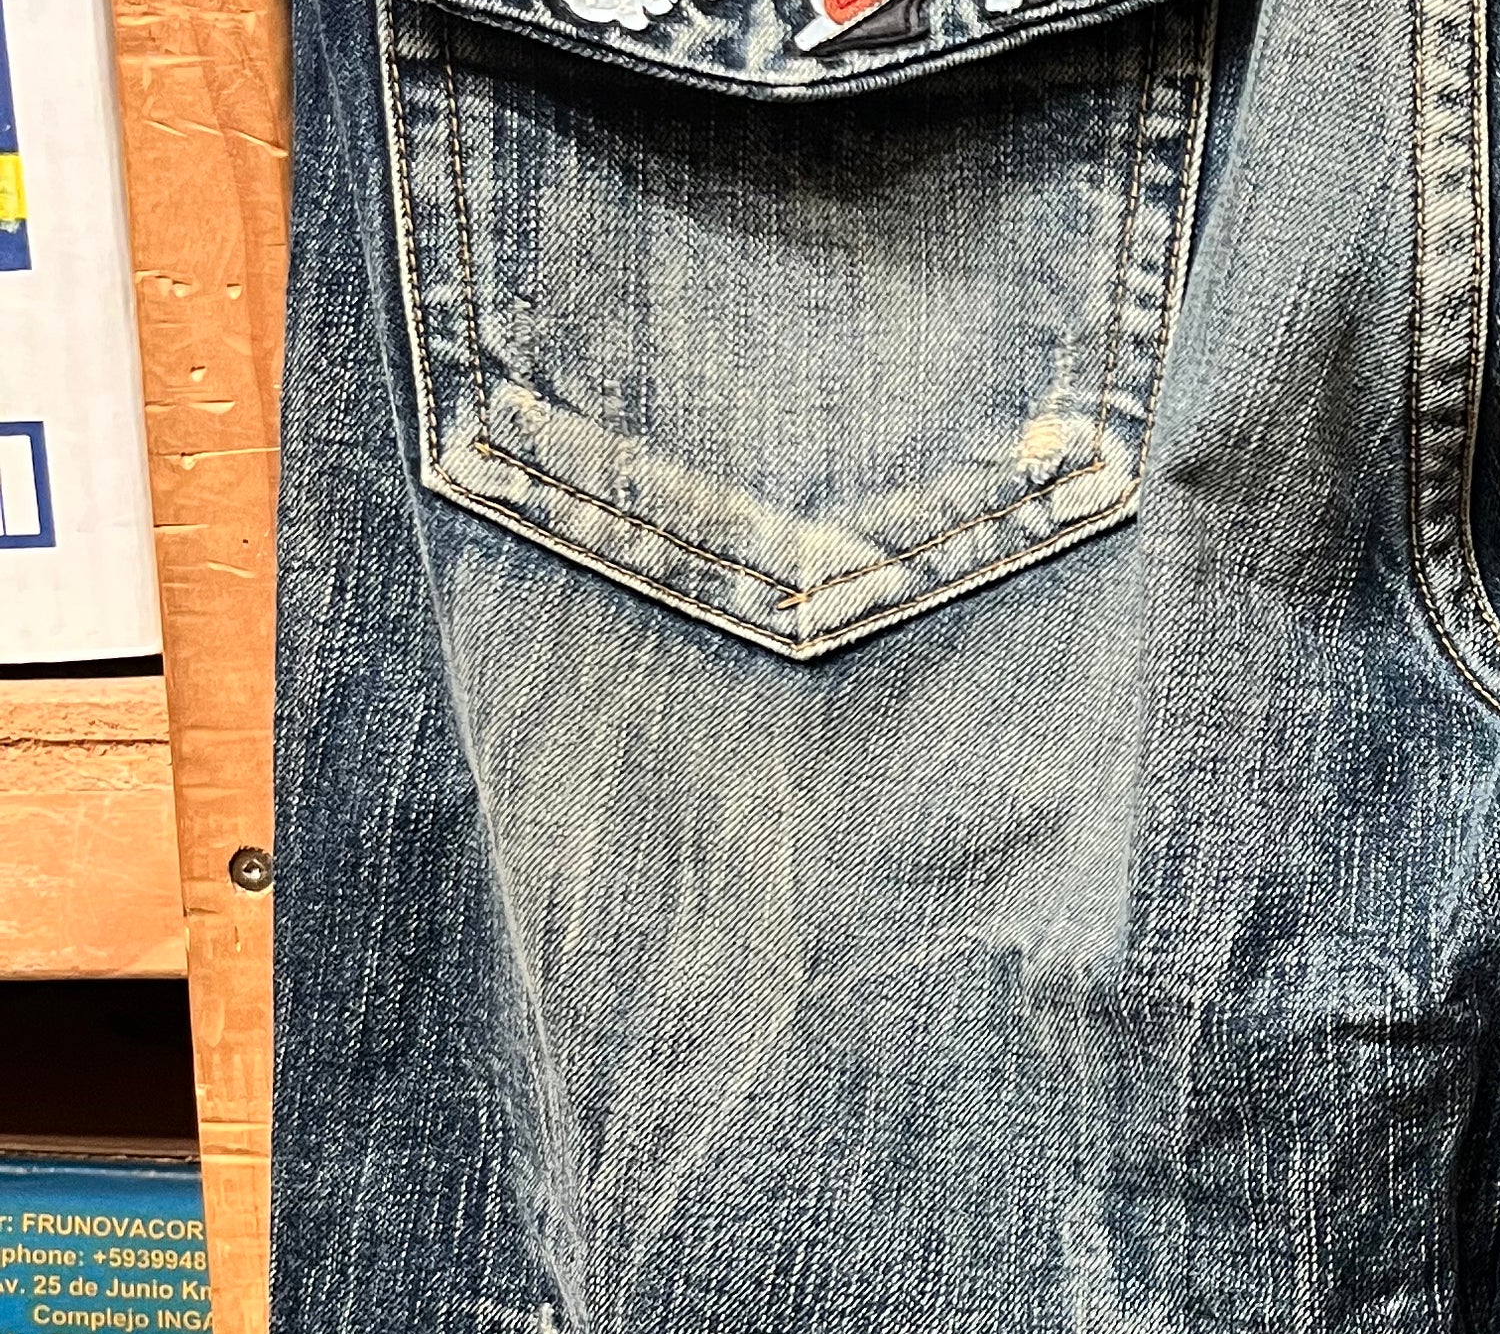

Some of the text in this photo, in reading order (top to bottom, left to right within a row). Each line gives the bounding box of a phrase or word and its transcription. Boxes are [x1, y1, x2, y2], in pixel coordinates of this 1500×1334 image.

[22, 1213, 204, 1241] FRUNOVACOR
[93, 1247, 207, 1271] +5939948
[33, 1275, 174, 1300] 25 de Junio
[34, 1304, 150, 1333] Complejo
